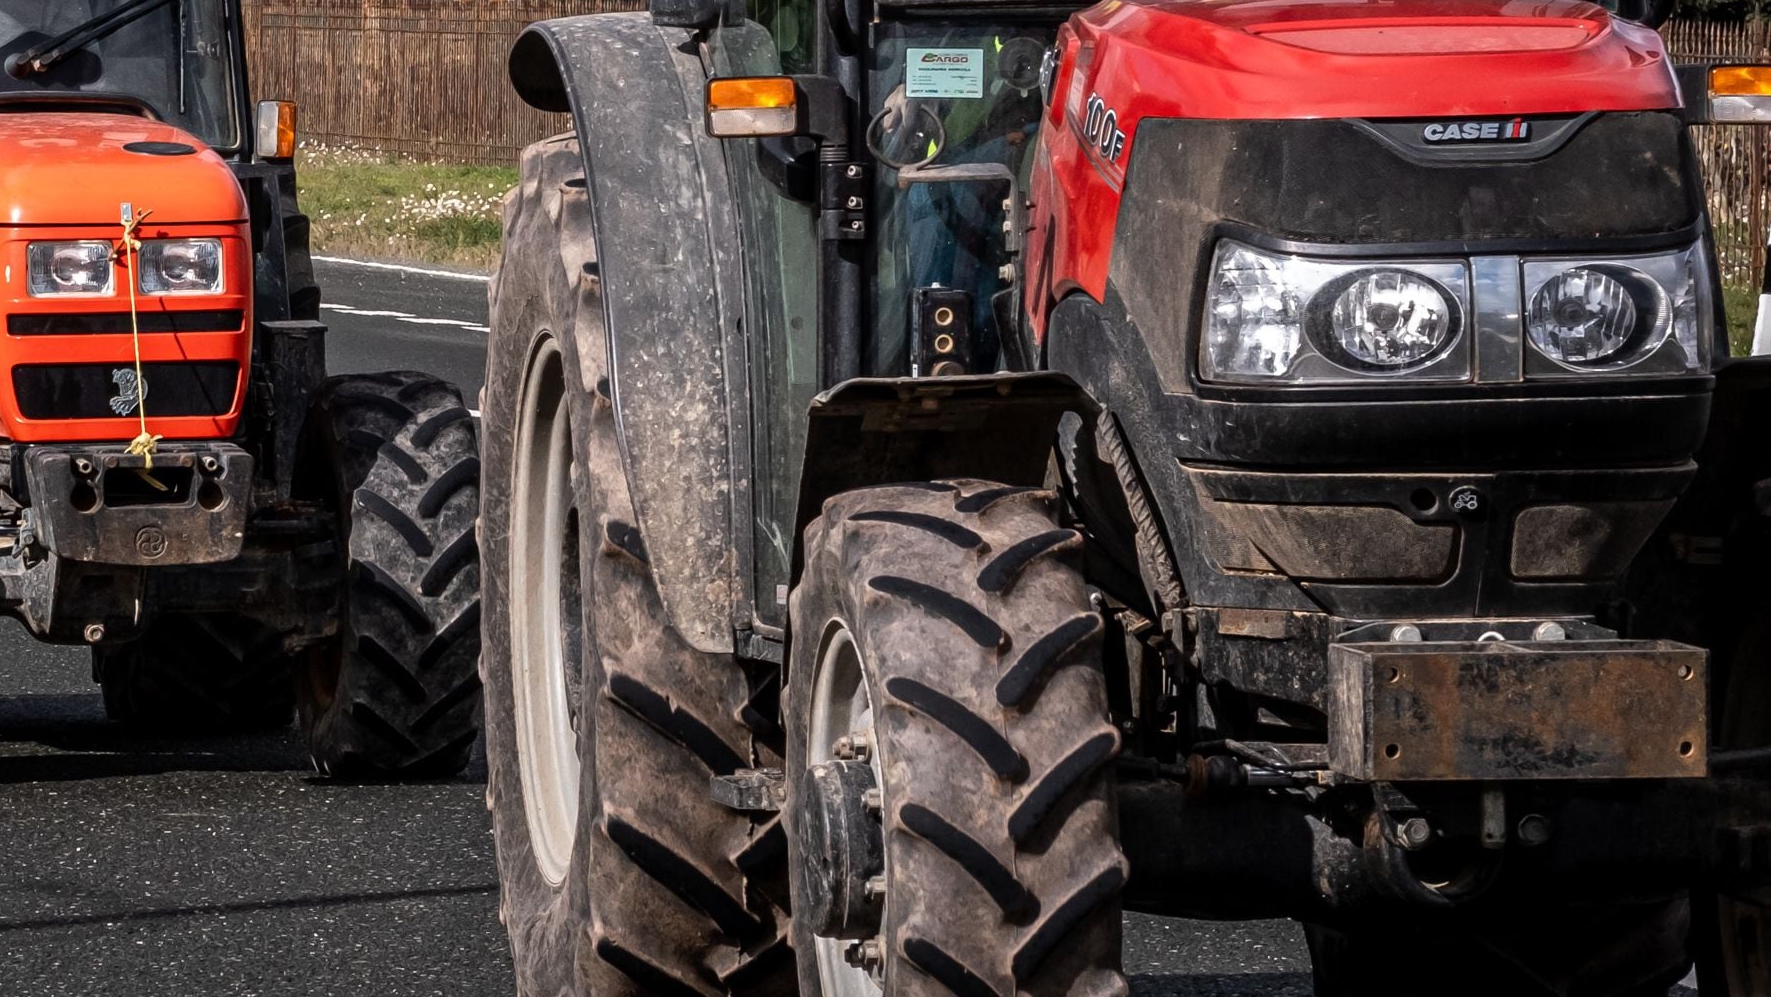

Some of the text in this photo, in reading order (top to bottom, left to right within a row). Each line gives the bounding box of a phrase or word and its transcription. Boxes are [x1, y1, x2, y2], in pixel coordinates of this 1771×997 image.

[921, 52, 969, 63] CARGO
[1083, 91, 1126, 164] 100F
[1424, 122, 1499, 141] CASE
